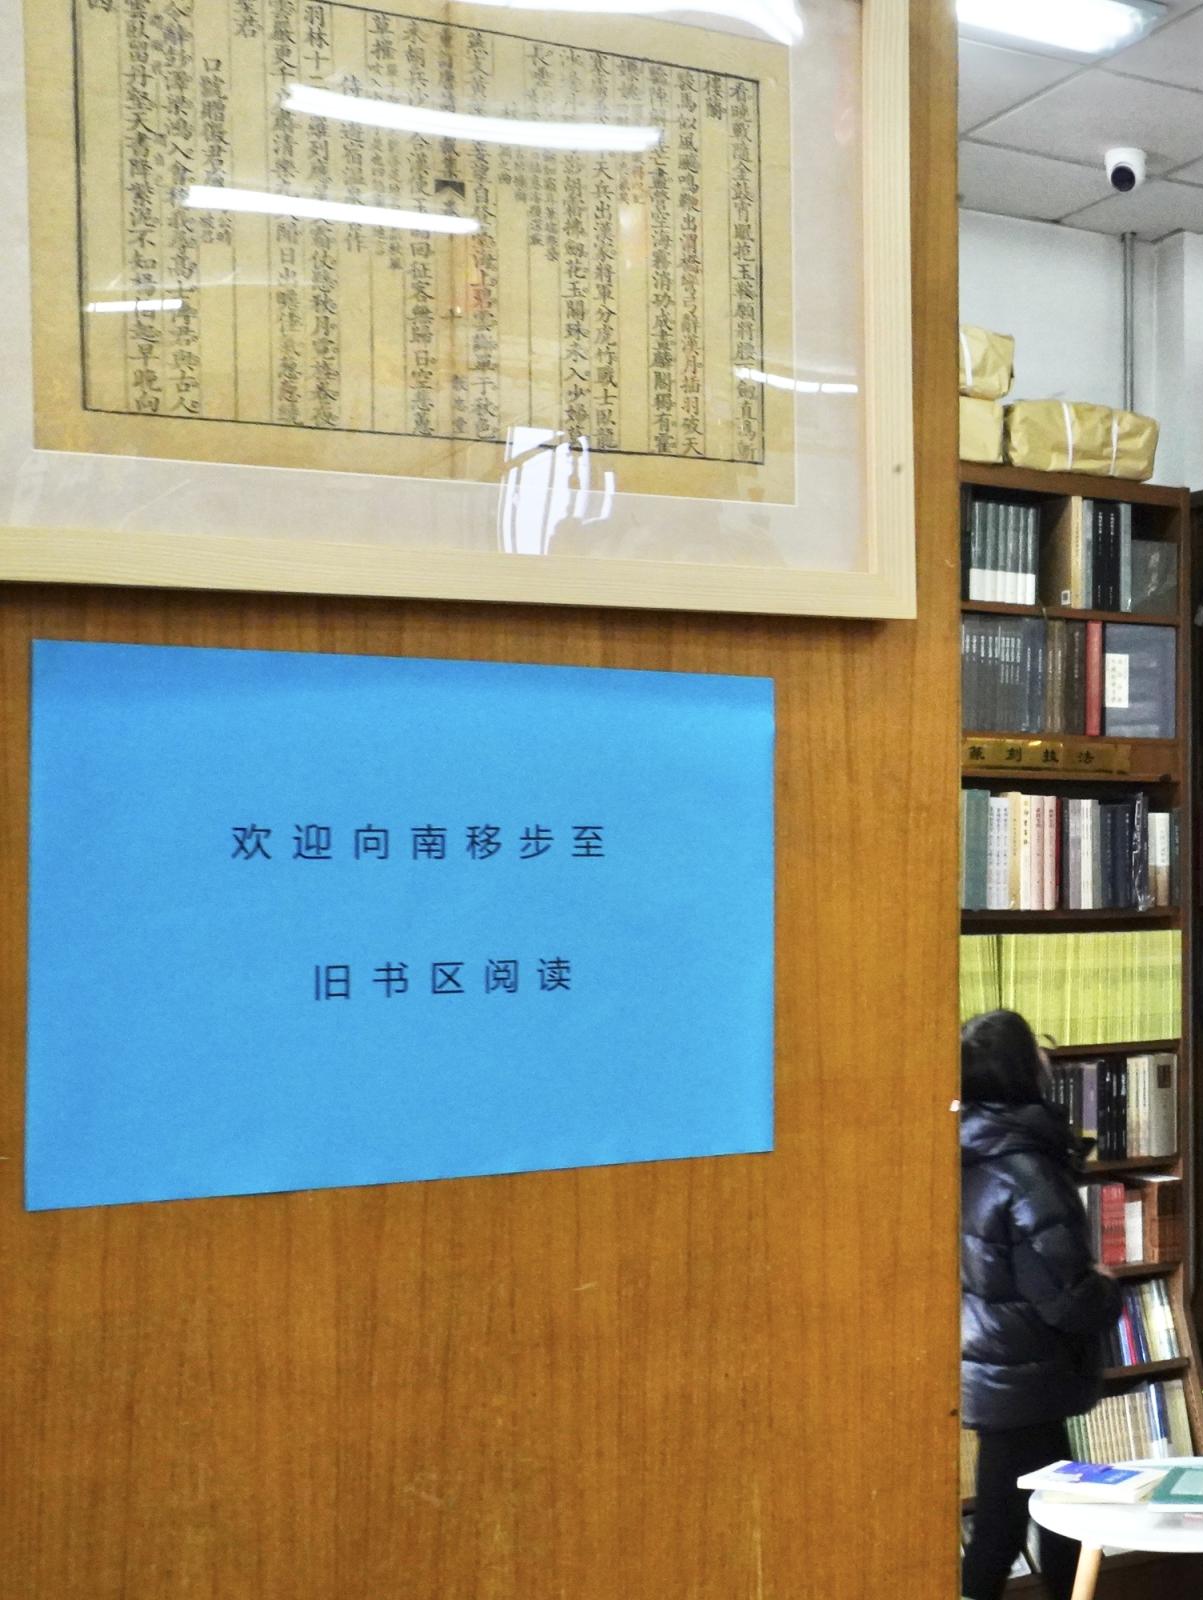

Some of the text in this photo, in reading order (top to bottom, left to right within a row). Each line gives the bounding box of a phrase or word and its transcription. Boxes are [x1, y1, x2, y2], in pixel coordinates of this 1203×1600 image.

[231, 823, 606, 861] 欢迎向南移步至
[314, 956, 572, 1001] 旧书区阅读
